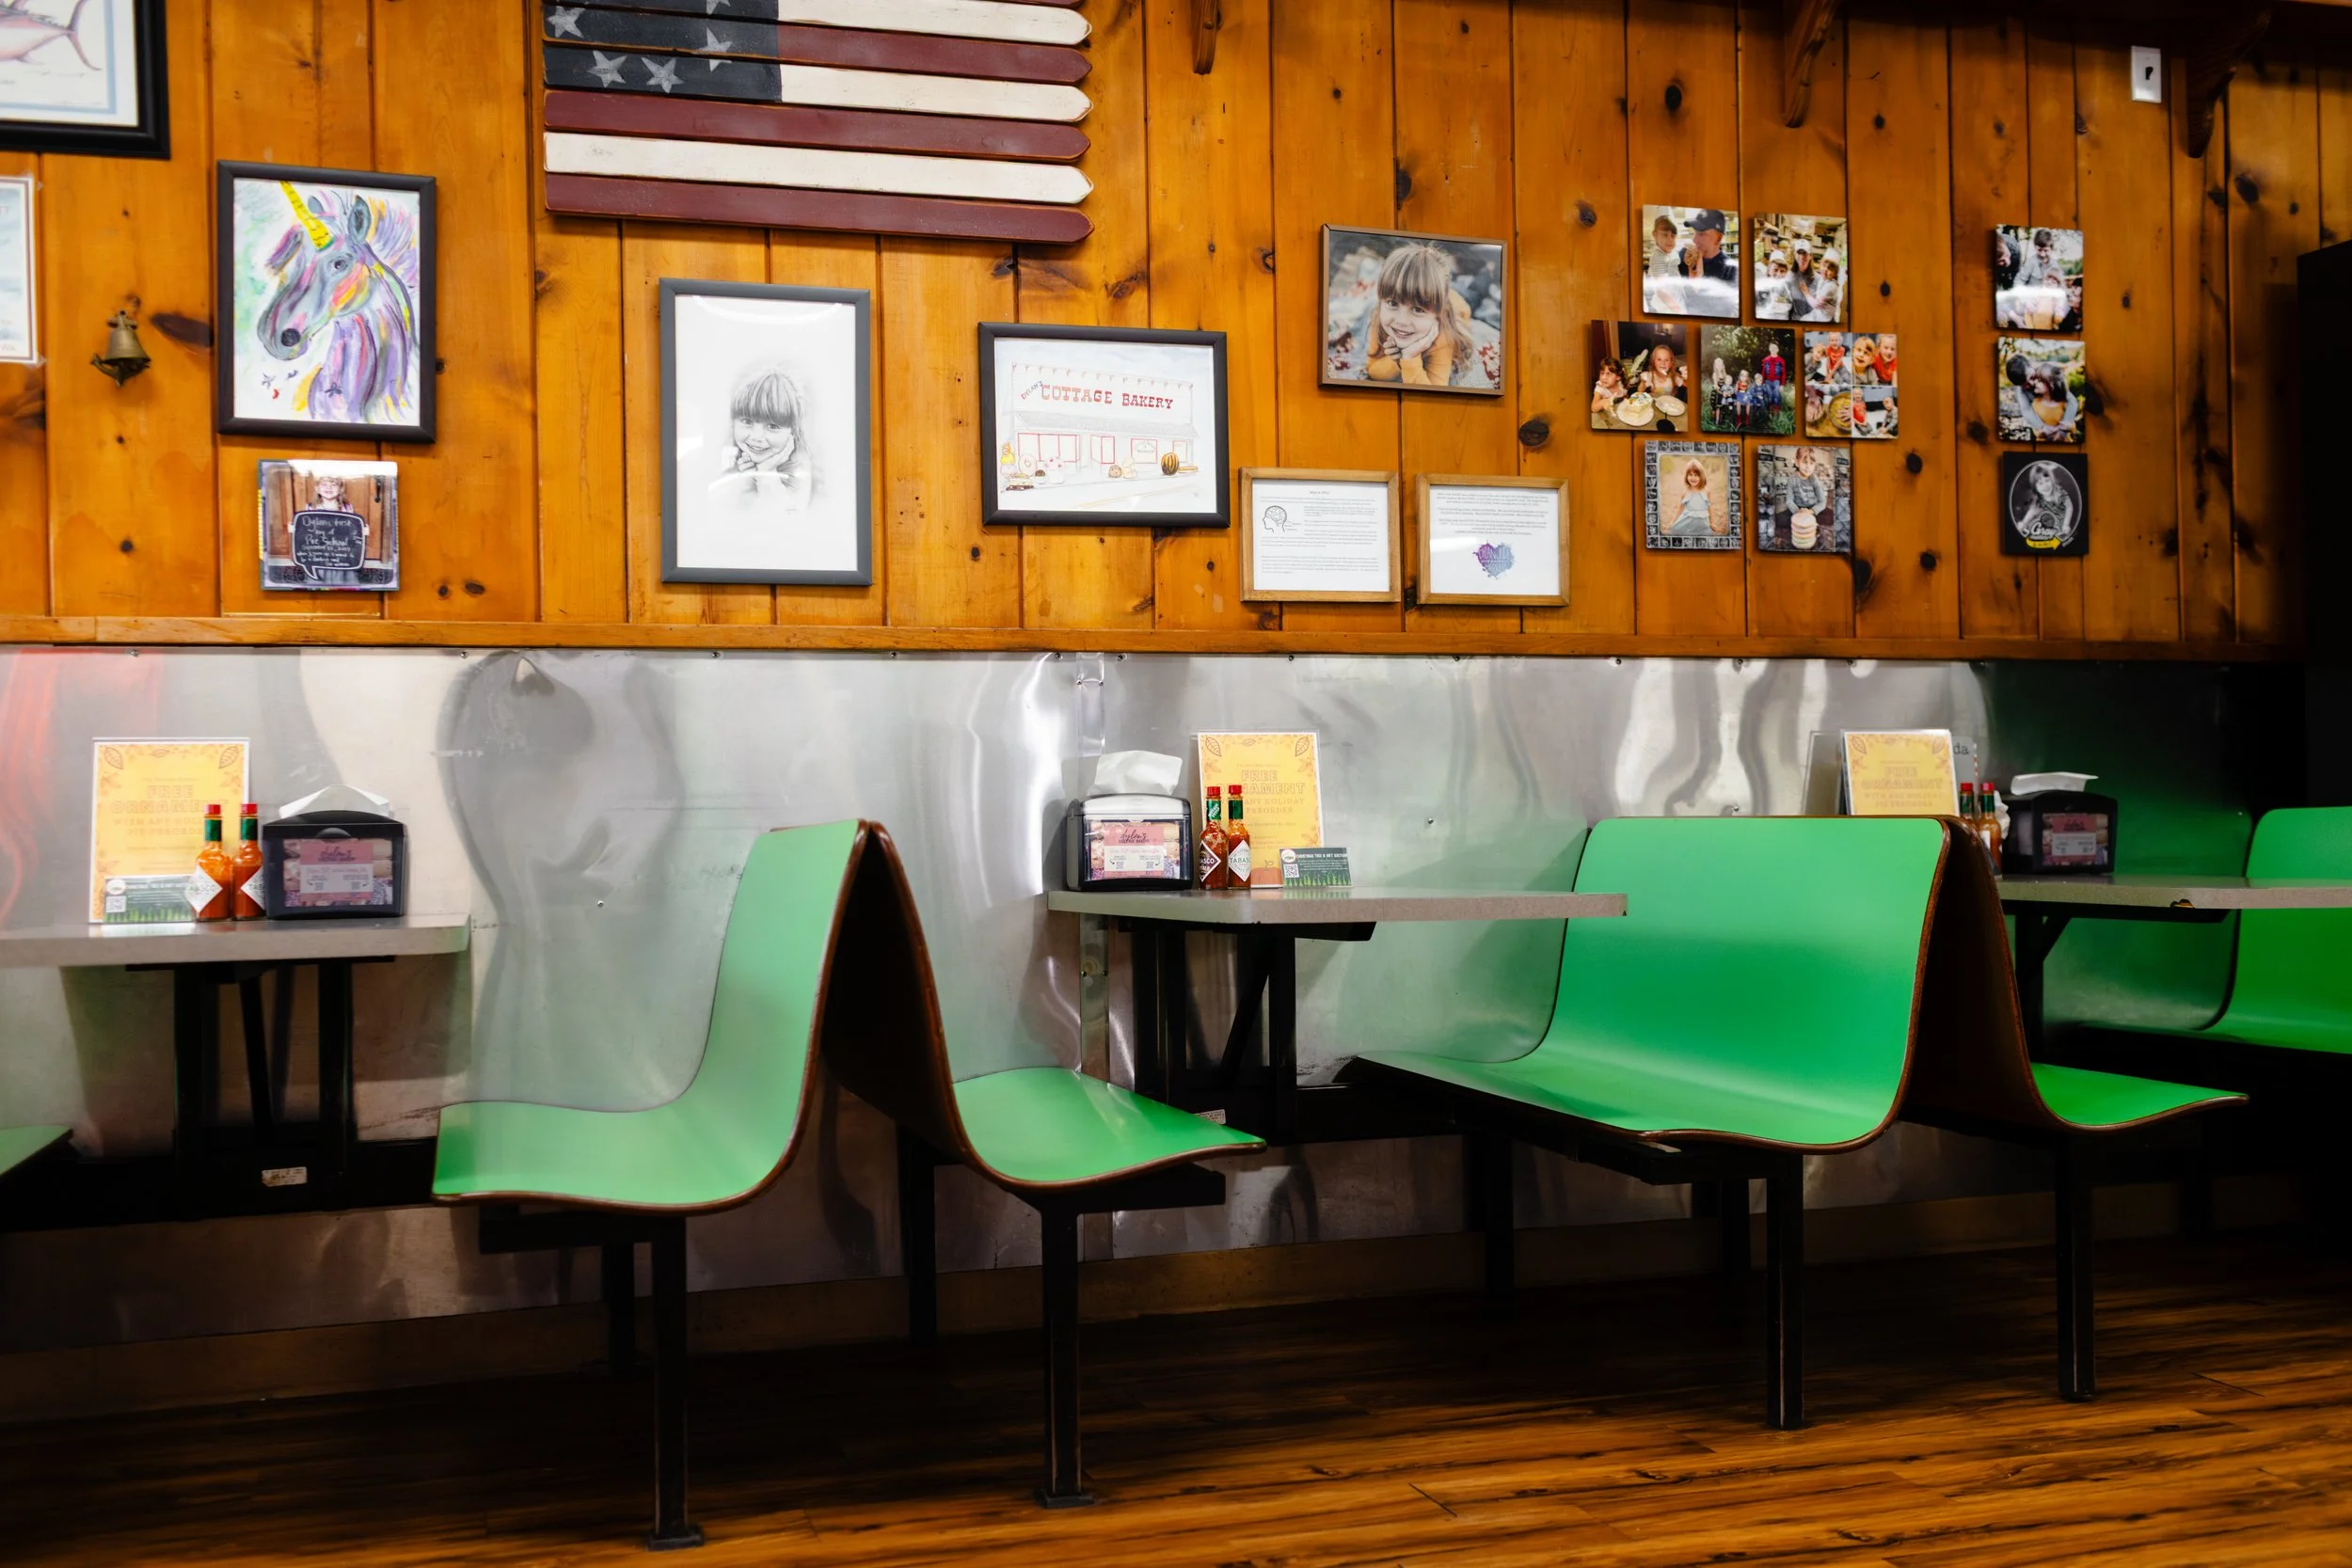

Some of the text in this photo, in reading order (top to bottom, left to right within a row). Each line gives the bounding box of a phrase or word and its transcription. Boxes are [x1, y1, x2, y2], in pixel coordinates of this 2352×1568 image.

[1041, 384, 1174, 409] COTTAGE BAKERY
[1241, 769, 1279, 782] FREE
[147, 784, 194, 799] FREE
[1219, 783, 1306, 795] ONAMENT
[174, 817, 203, 826] HOLI
